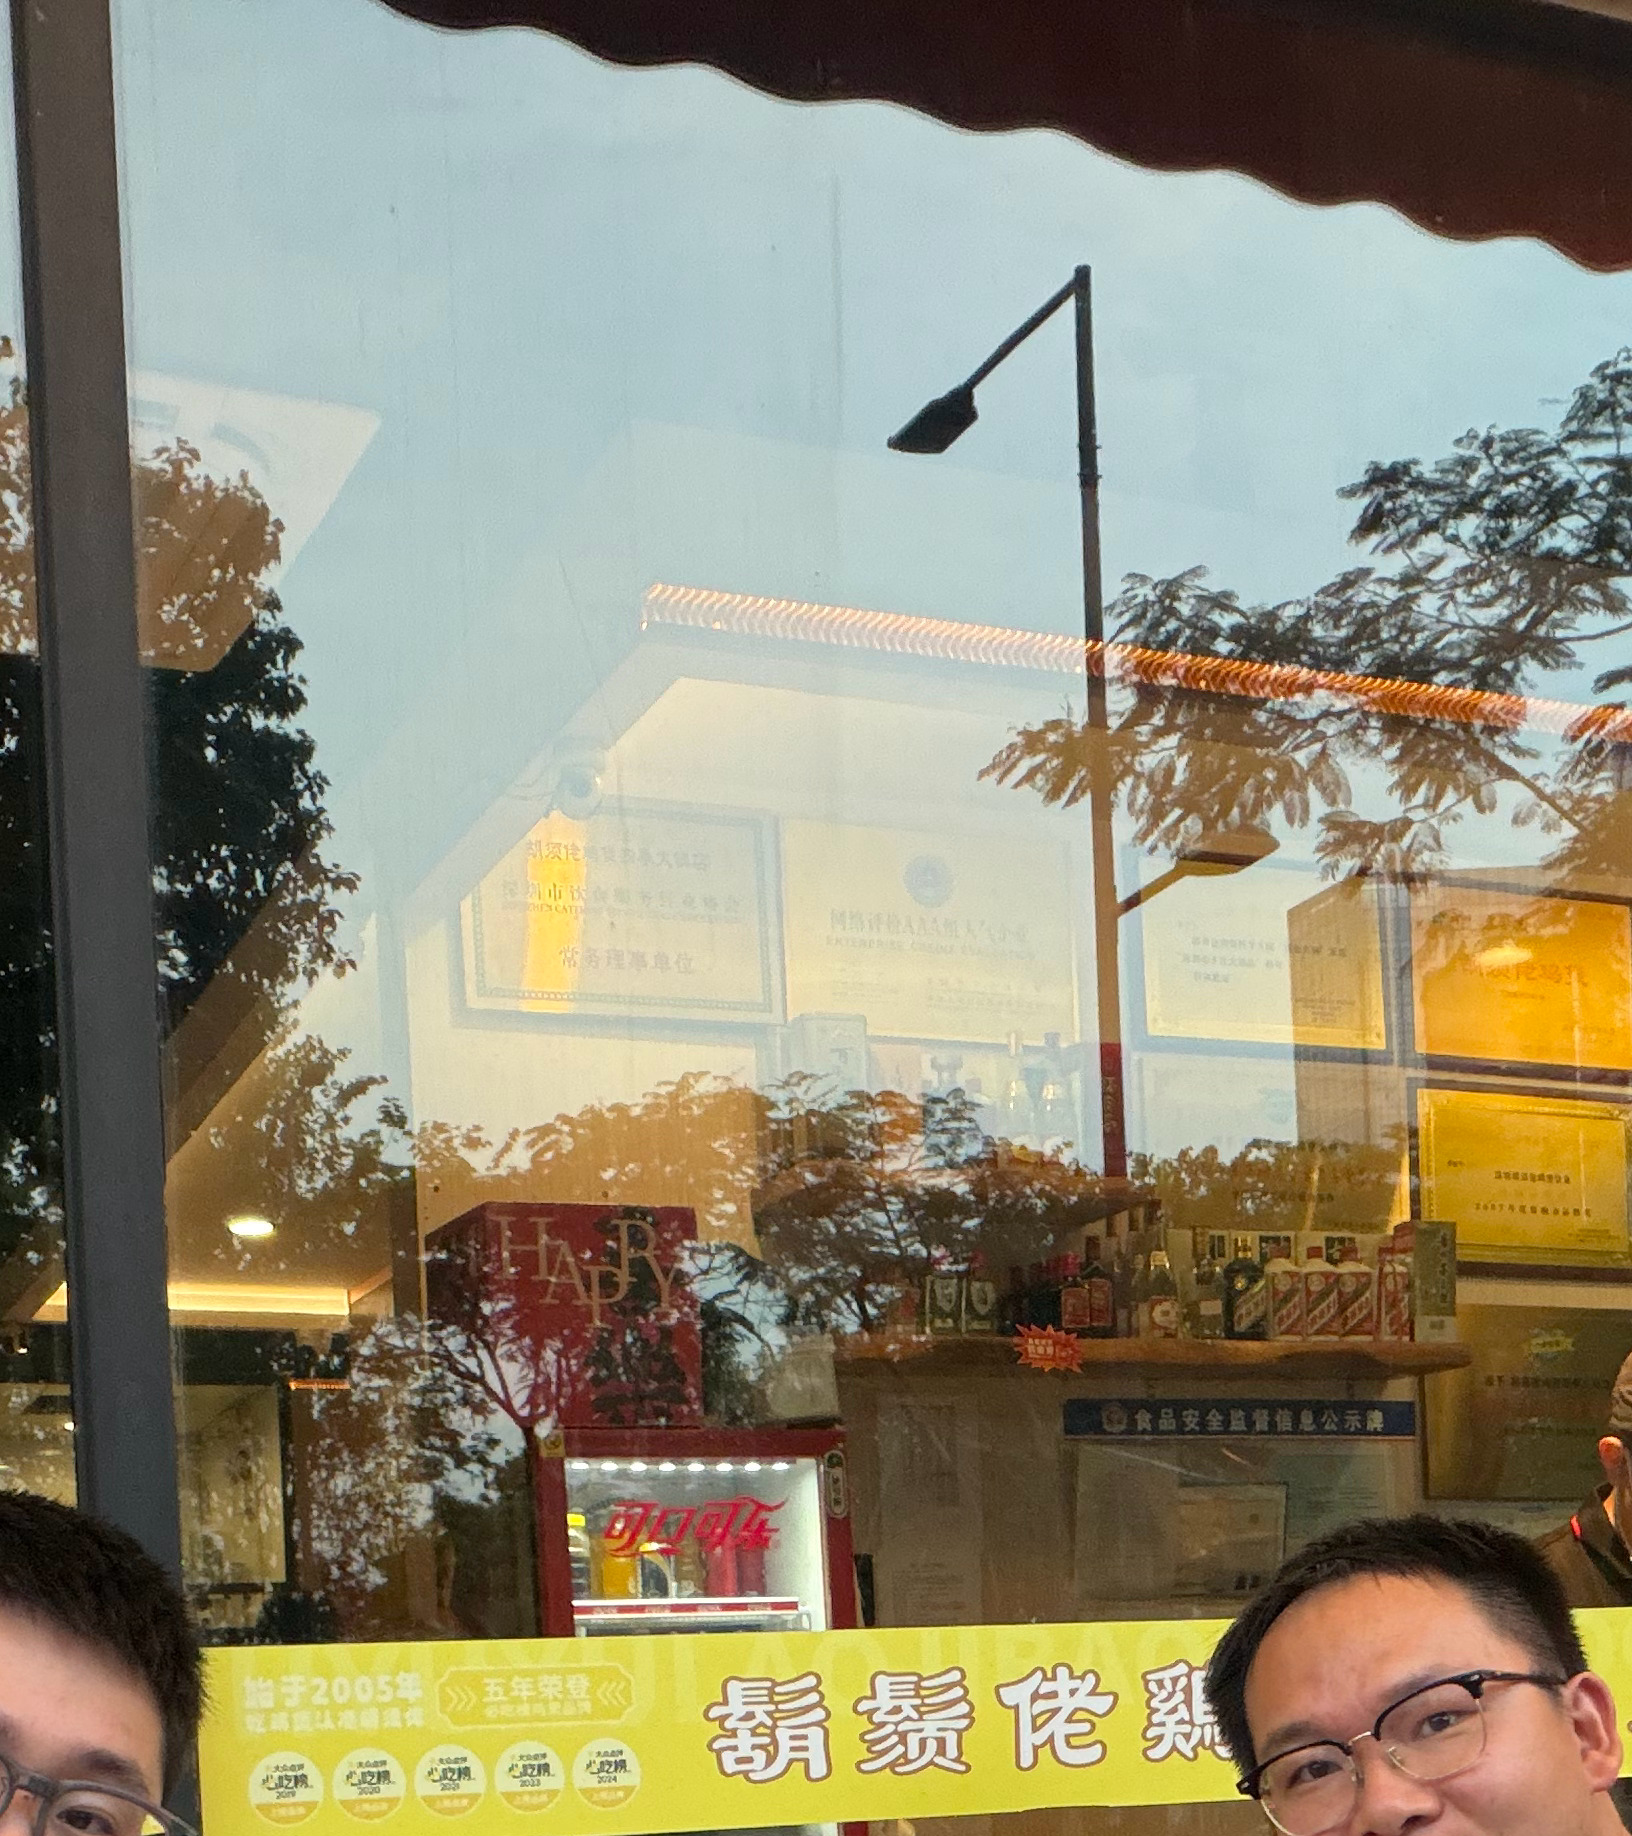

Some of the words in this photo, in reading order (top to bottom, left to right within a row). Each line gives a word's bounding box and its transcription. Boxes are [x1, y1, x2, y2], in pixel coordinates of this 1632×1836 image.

[1134, 1407, 1385, 1433] 食品安全监督信息公示牌
[603, 1494, 789, 1558] 可口可乐
[482, 1672, 591, 1704] 五年荣登
